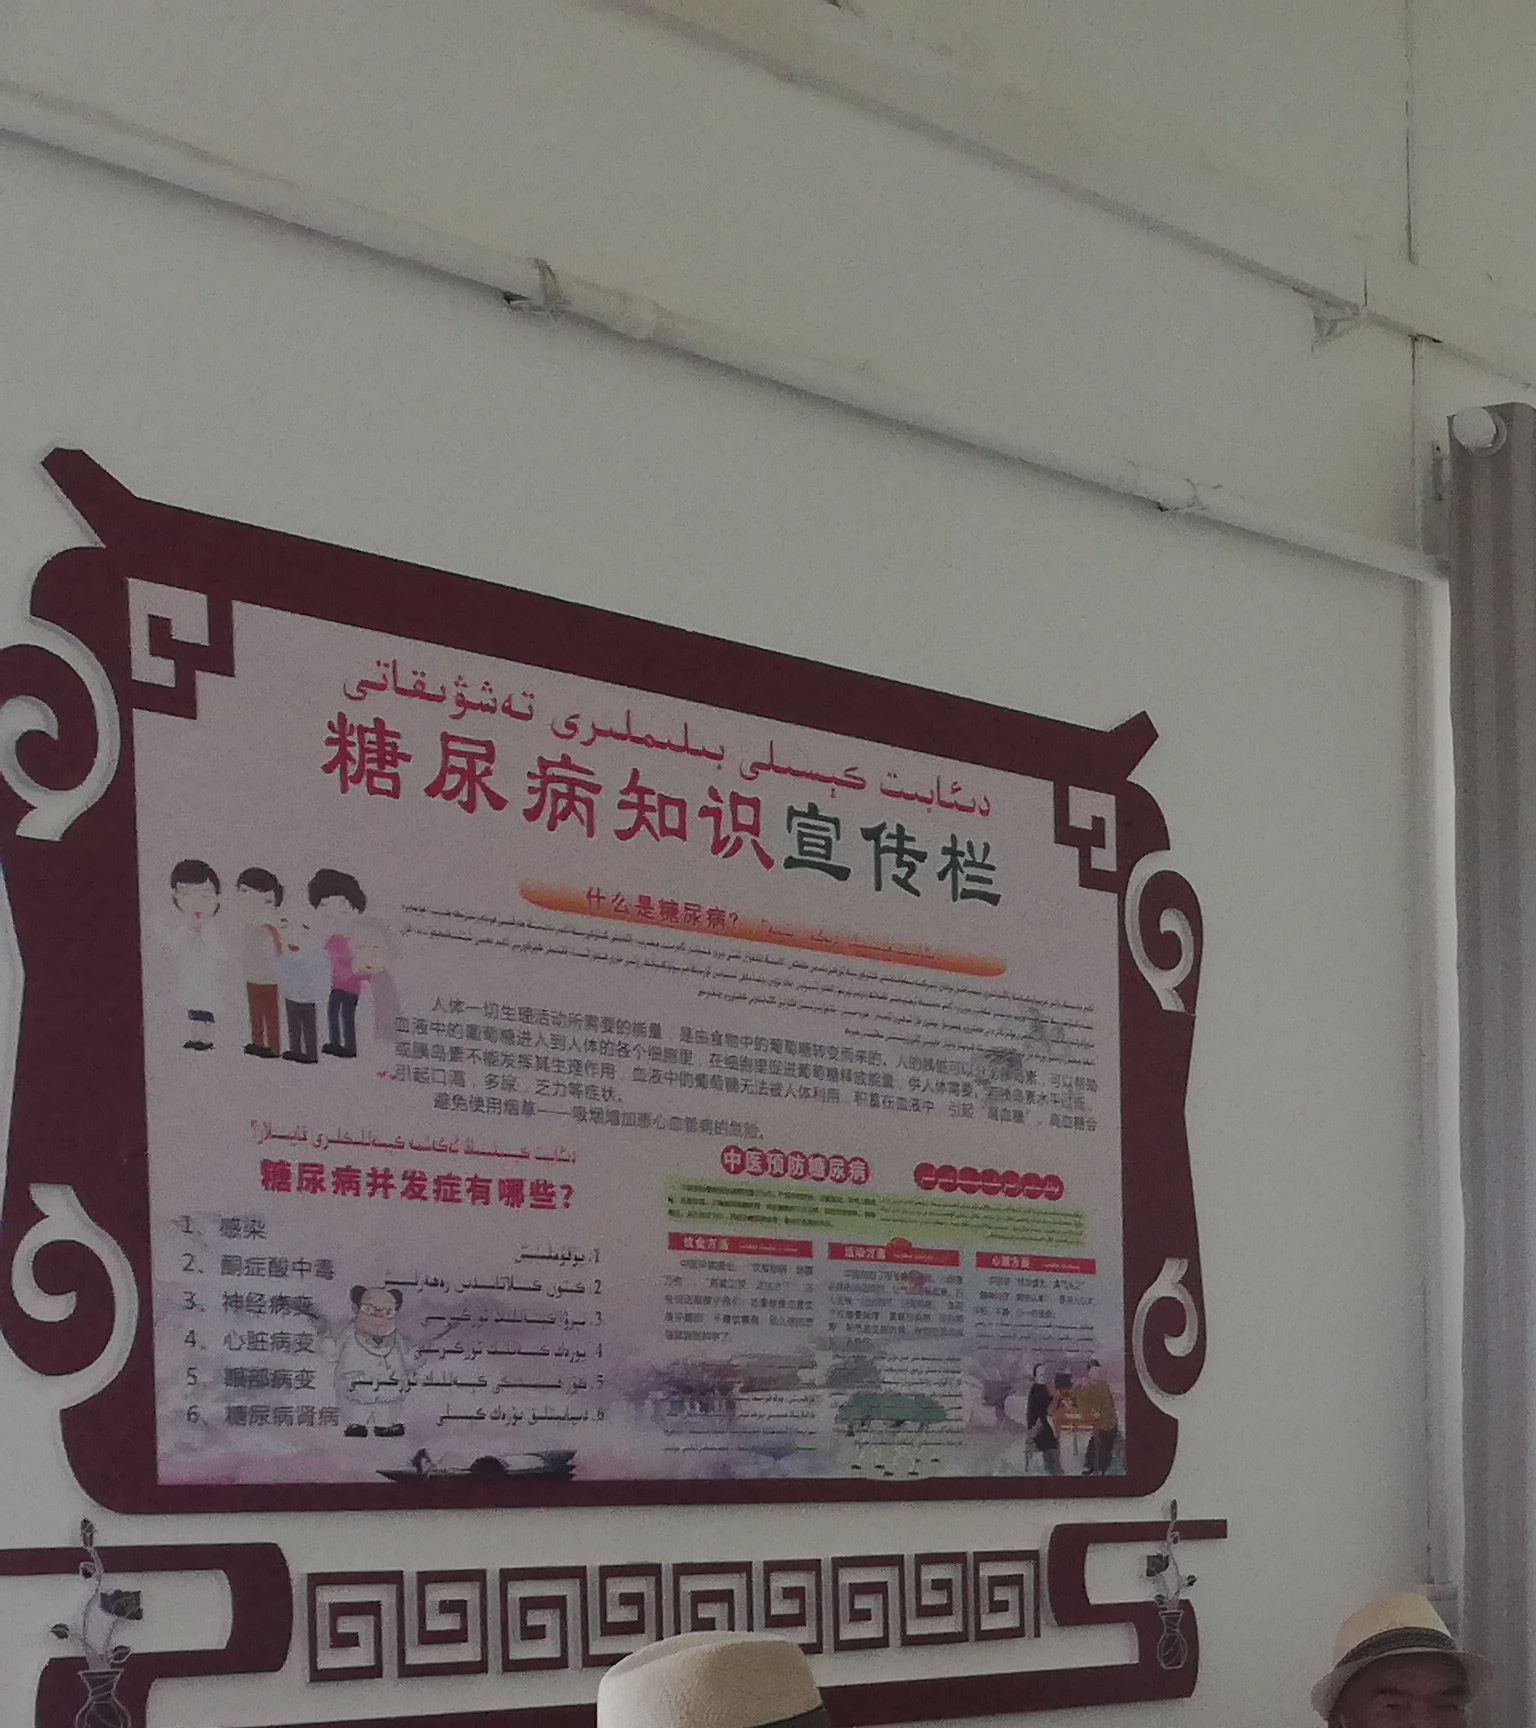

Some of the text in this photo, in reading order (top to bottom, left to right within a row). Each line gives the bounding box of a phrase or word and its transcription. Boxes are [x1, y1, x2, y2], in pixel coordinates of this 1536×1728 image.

[321, 711, 1002, 906] 糖尿病知识宣传栏
[723, 1148, 867, 1182] 中医预防糖尿病
